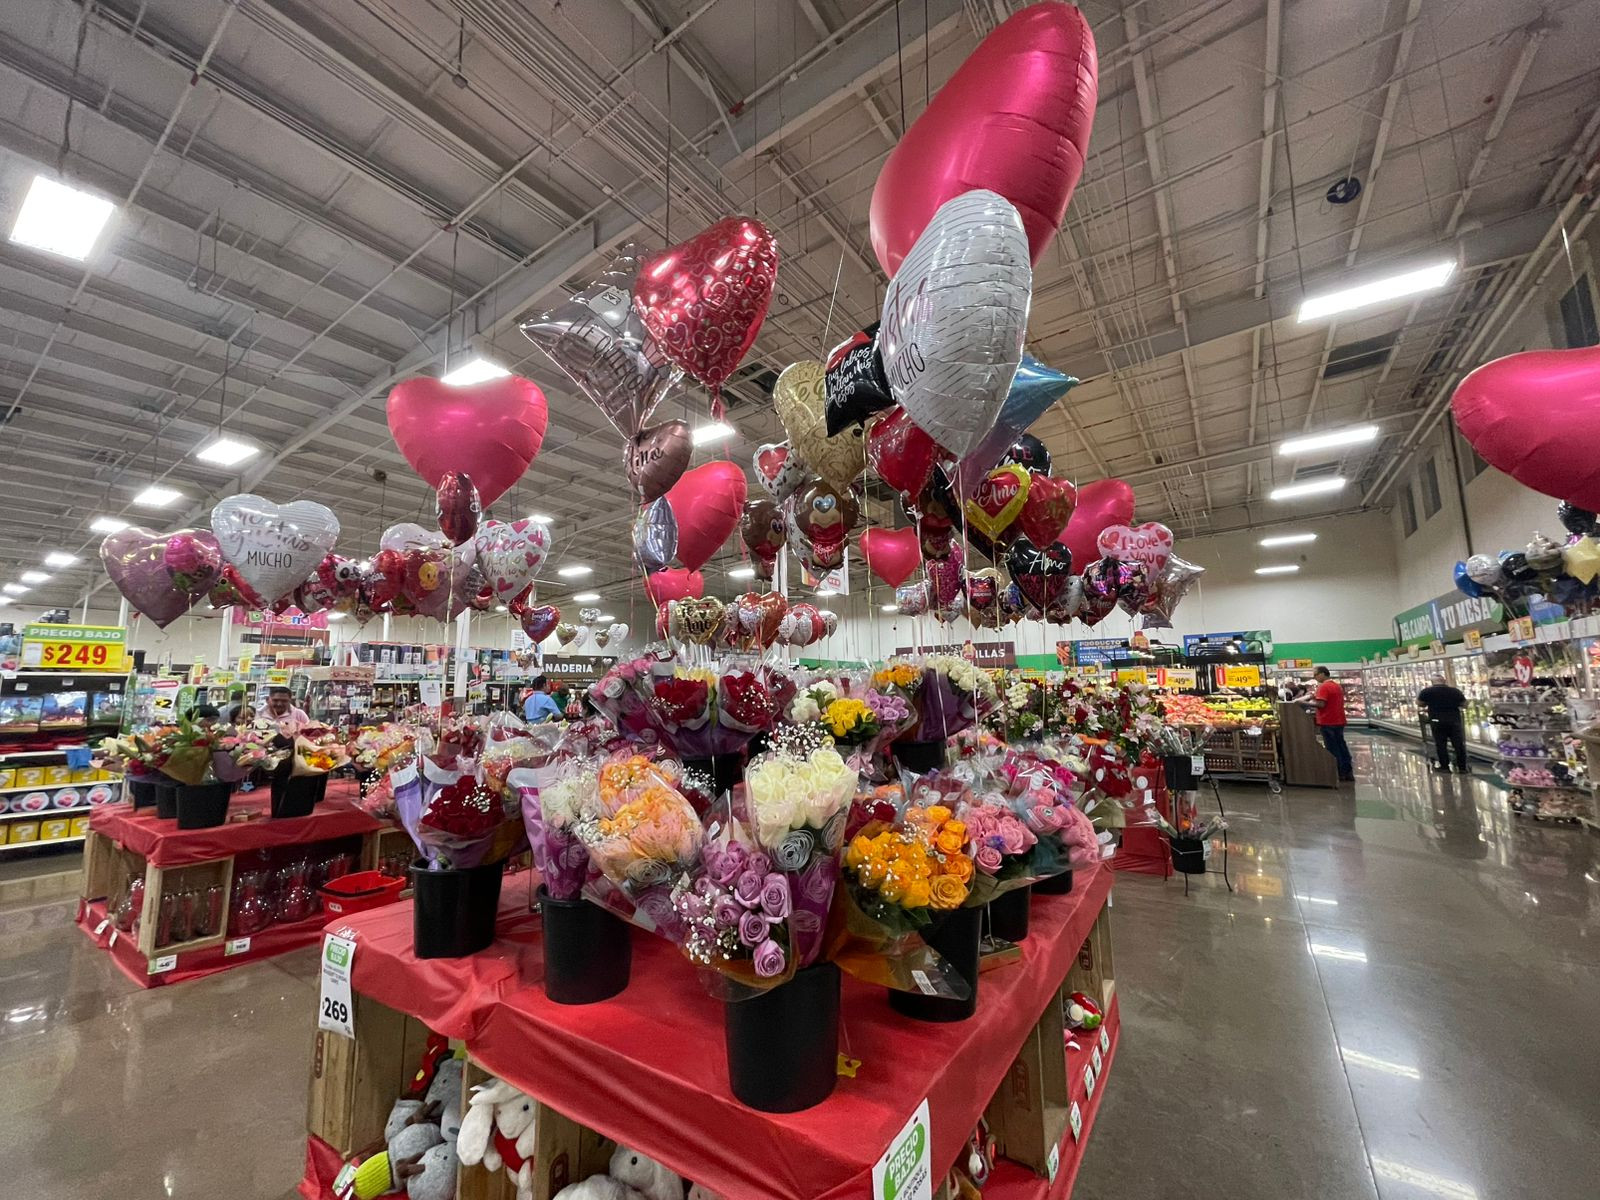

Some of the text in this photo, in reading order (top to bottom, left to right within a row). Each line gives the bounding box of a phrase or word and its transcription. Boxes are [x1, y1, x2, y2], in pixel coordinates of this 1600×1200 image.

[978, 482, 1018, 508] Amo
[246, 549, 293, 569] MUCHO
[1431, 602, 1444, 640] A
[1440, 604, 1457, 631] TU
[1454, 596, 1493, 627] MESA
[30, 628, 121, 639] PRECIO BAJO
[44, 643, 107, 666] $249
[540, 662, 594, 674] ANADERIA
[889, 1130, 919, 1180] PRECIO
[895, 1150, 917, 1192] BAJO
